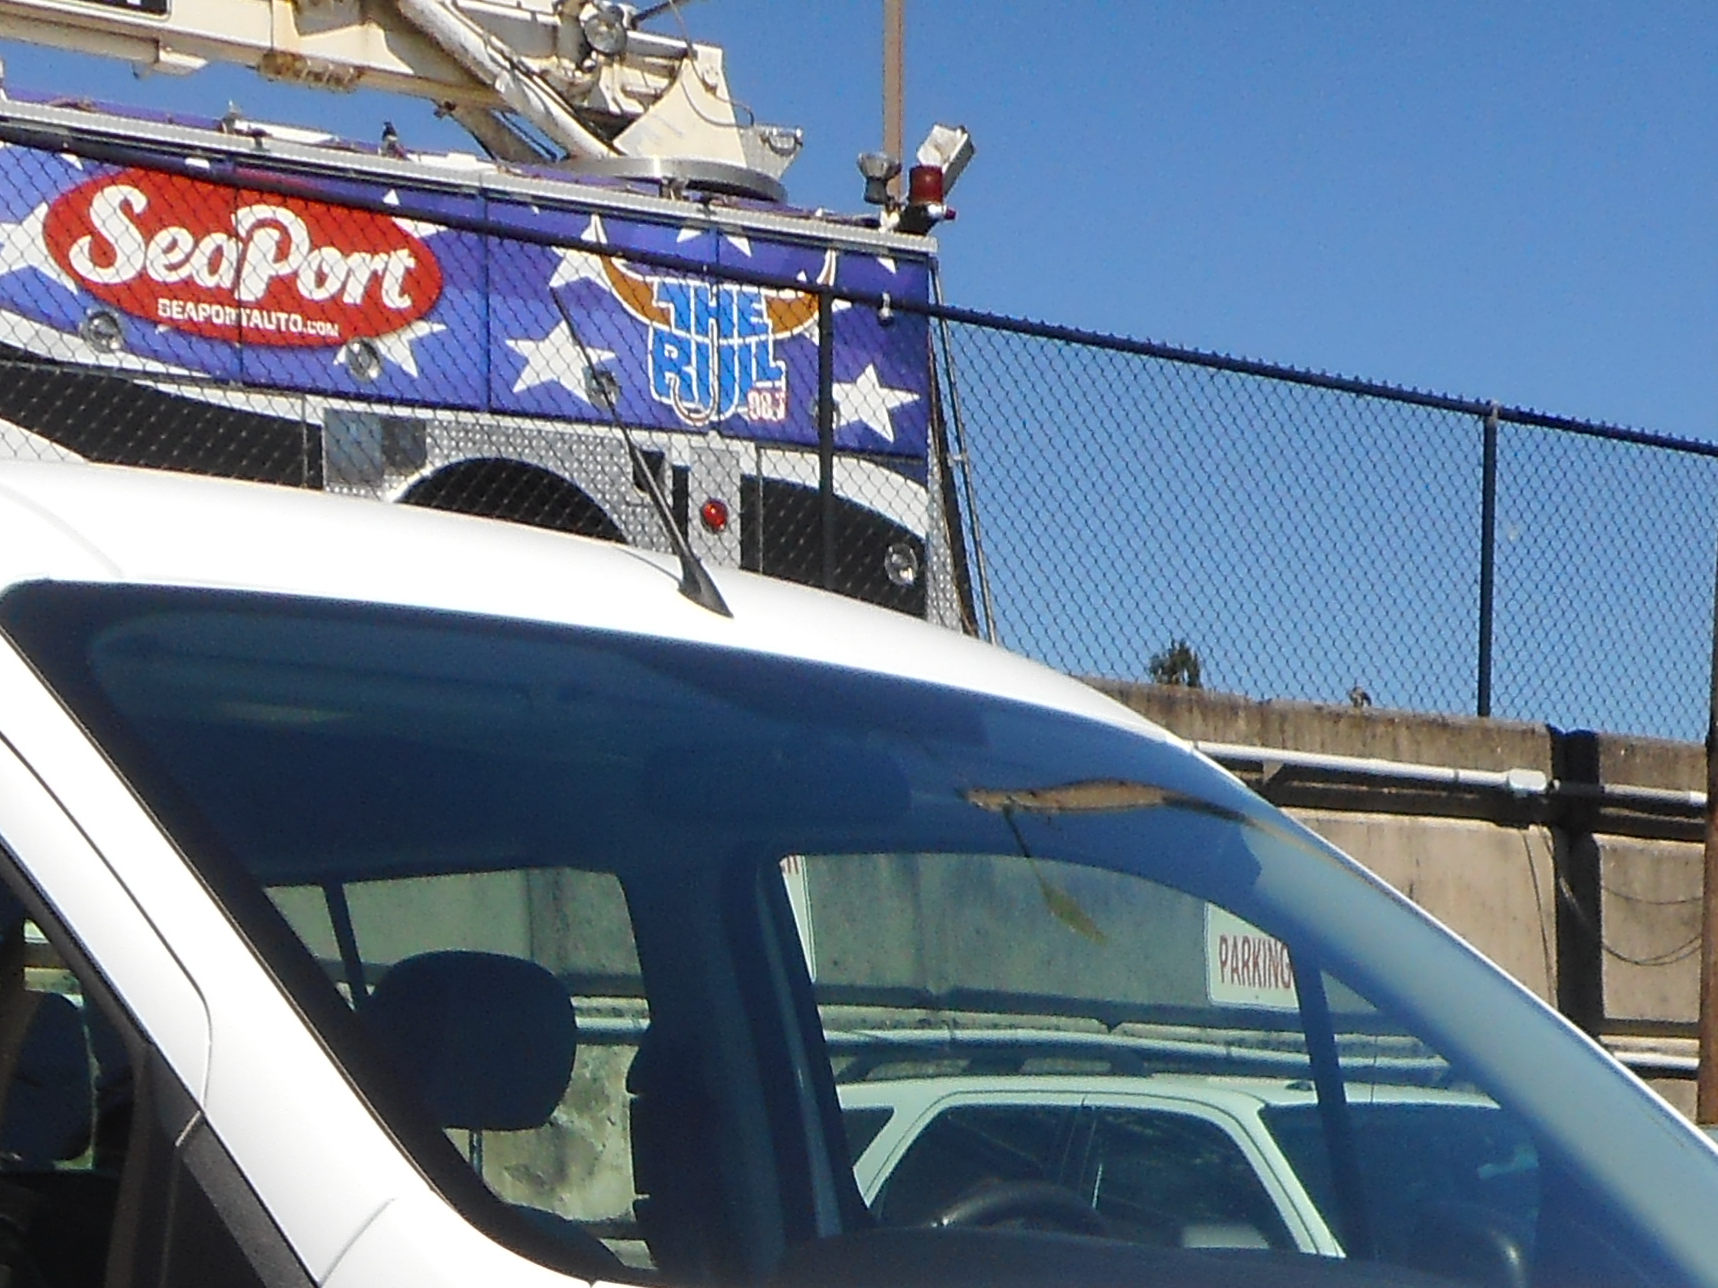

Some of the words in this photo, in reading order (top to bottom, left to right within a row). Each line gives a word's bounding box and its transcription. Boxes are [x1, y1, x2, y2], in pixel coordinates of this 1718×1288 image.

[68, 184, 416, 310] SeaPort
[157, 298, 340, 337] SEAPORTAUTO.COM
[653, 276, 772, 343] THE
[1219, 934, 1293, 989] PARKING
